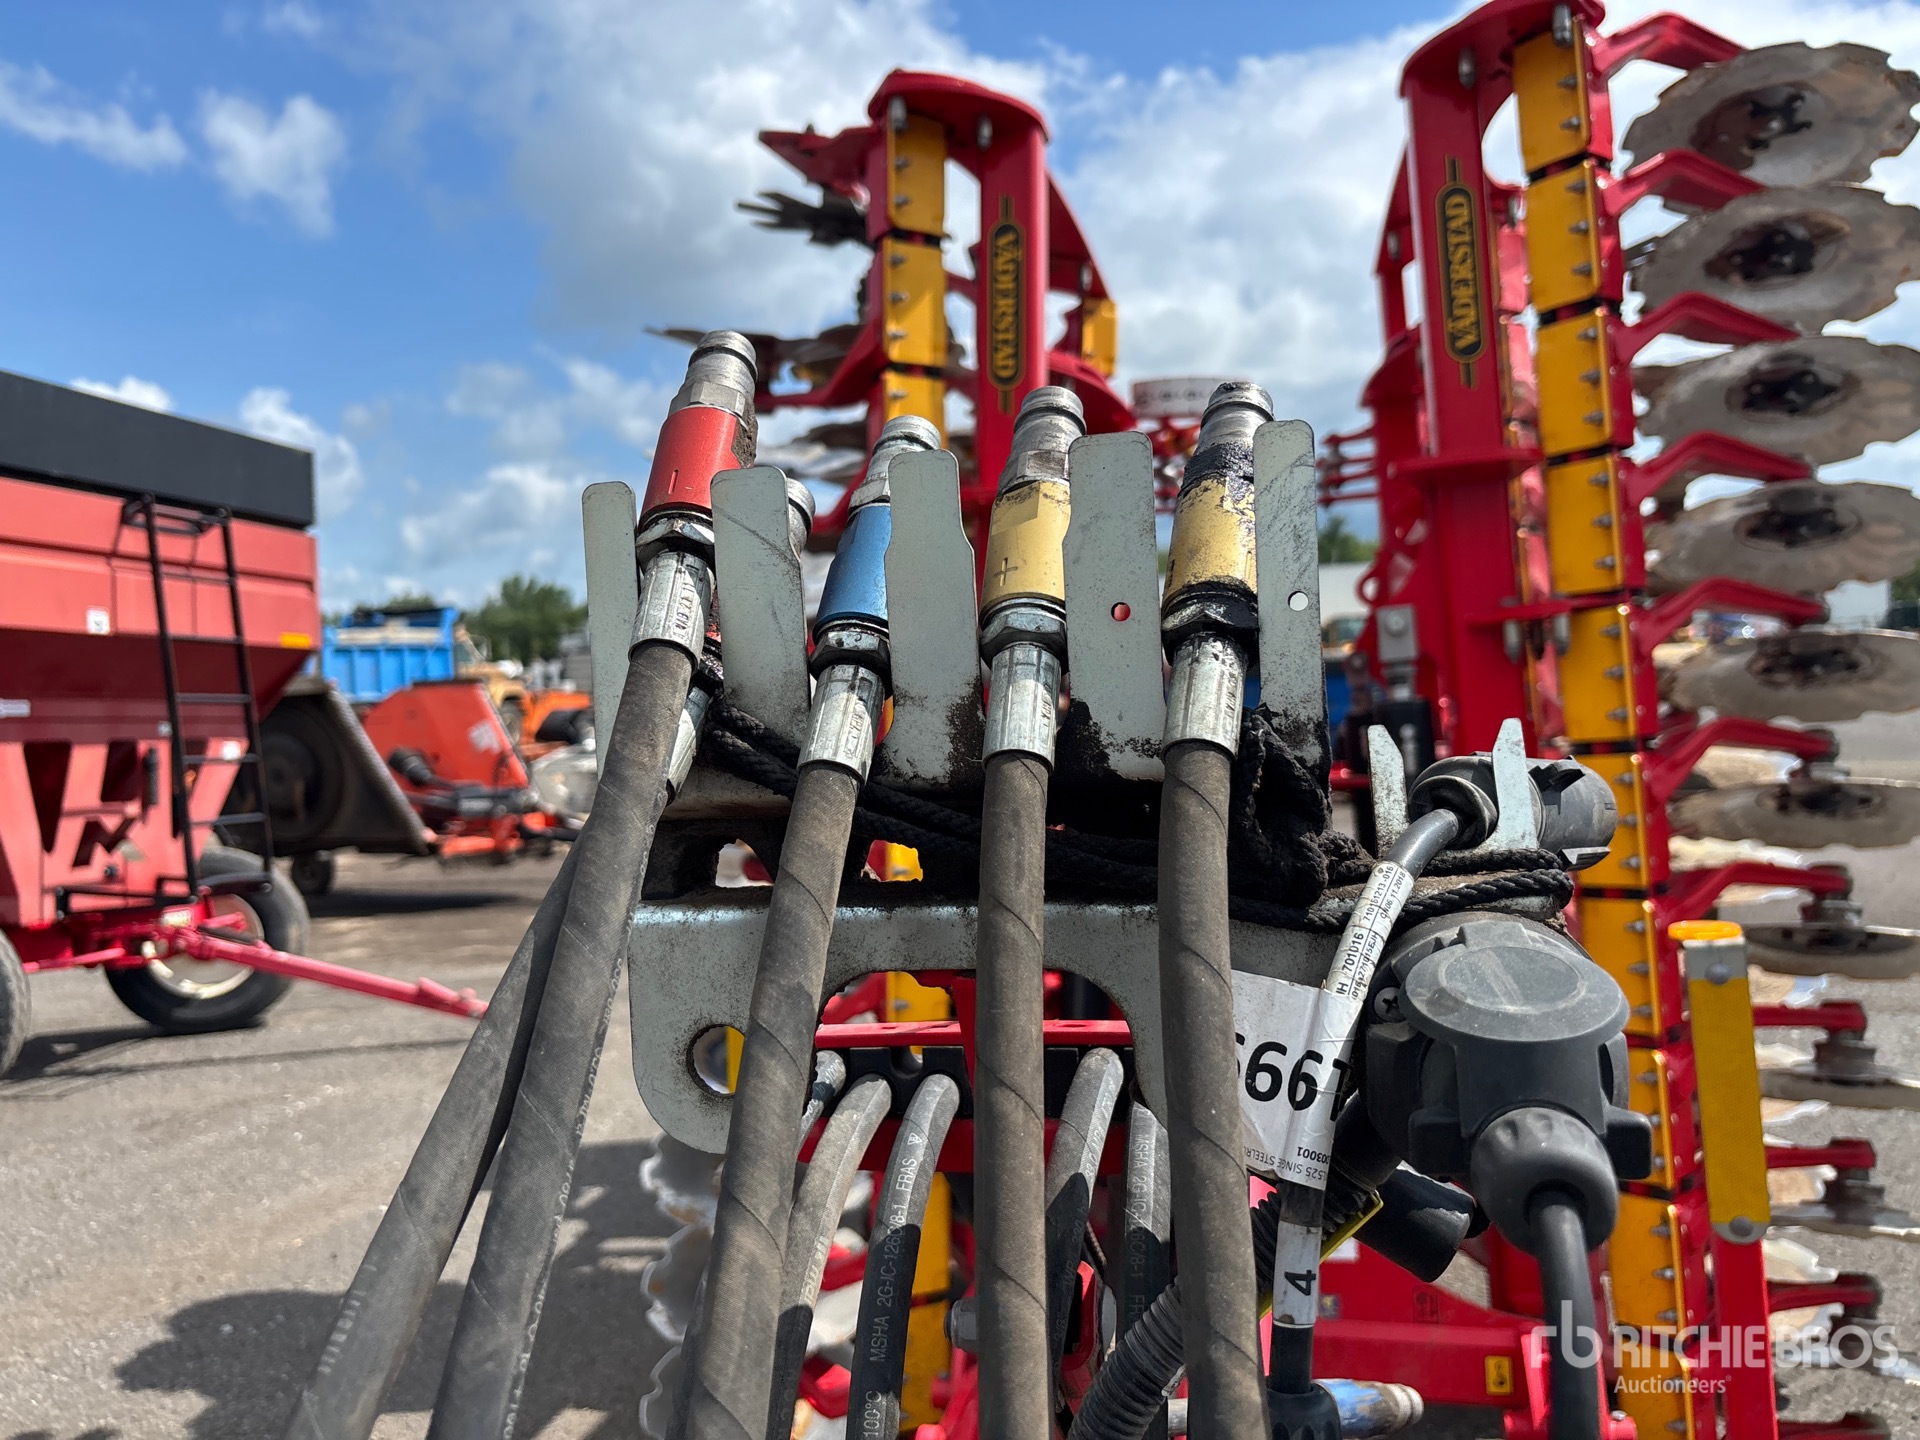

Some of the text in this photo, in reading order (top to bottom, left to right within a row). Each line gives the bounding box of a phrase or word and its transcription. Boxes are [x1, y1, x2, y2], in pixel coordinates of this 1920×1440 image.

[1341, 932, 1364, 973] 701016
[1133, 1133, 1150, 1169] MSHA
[869, 1315, 891, 1362] MSHA
[895, 1157, 918, 1192] FRAS
[1284, 1269, 1317, 1297] 4
